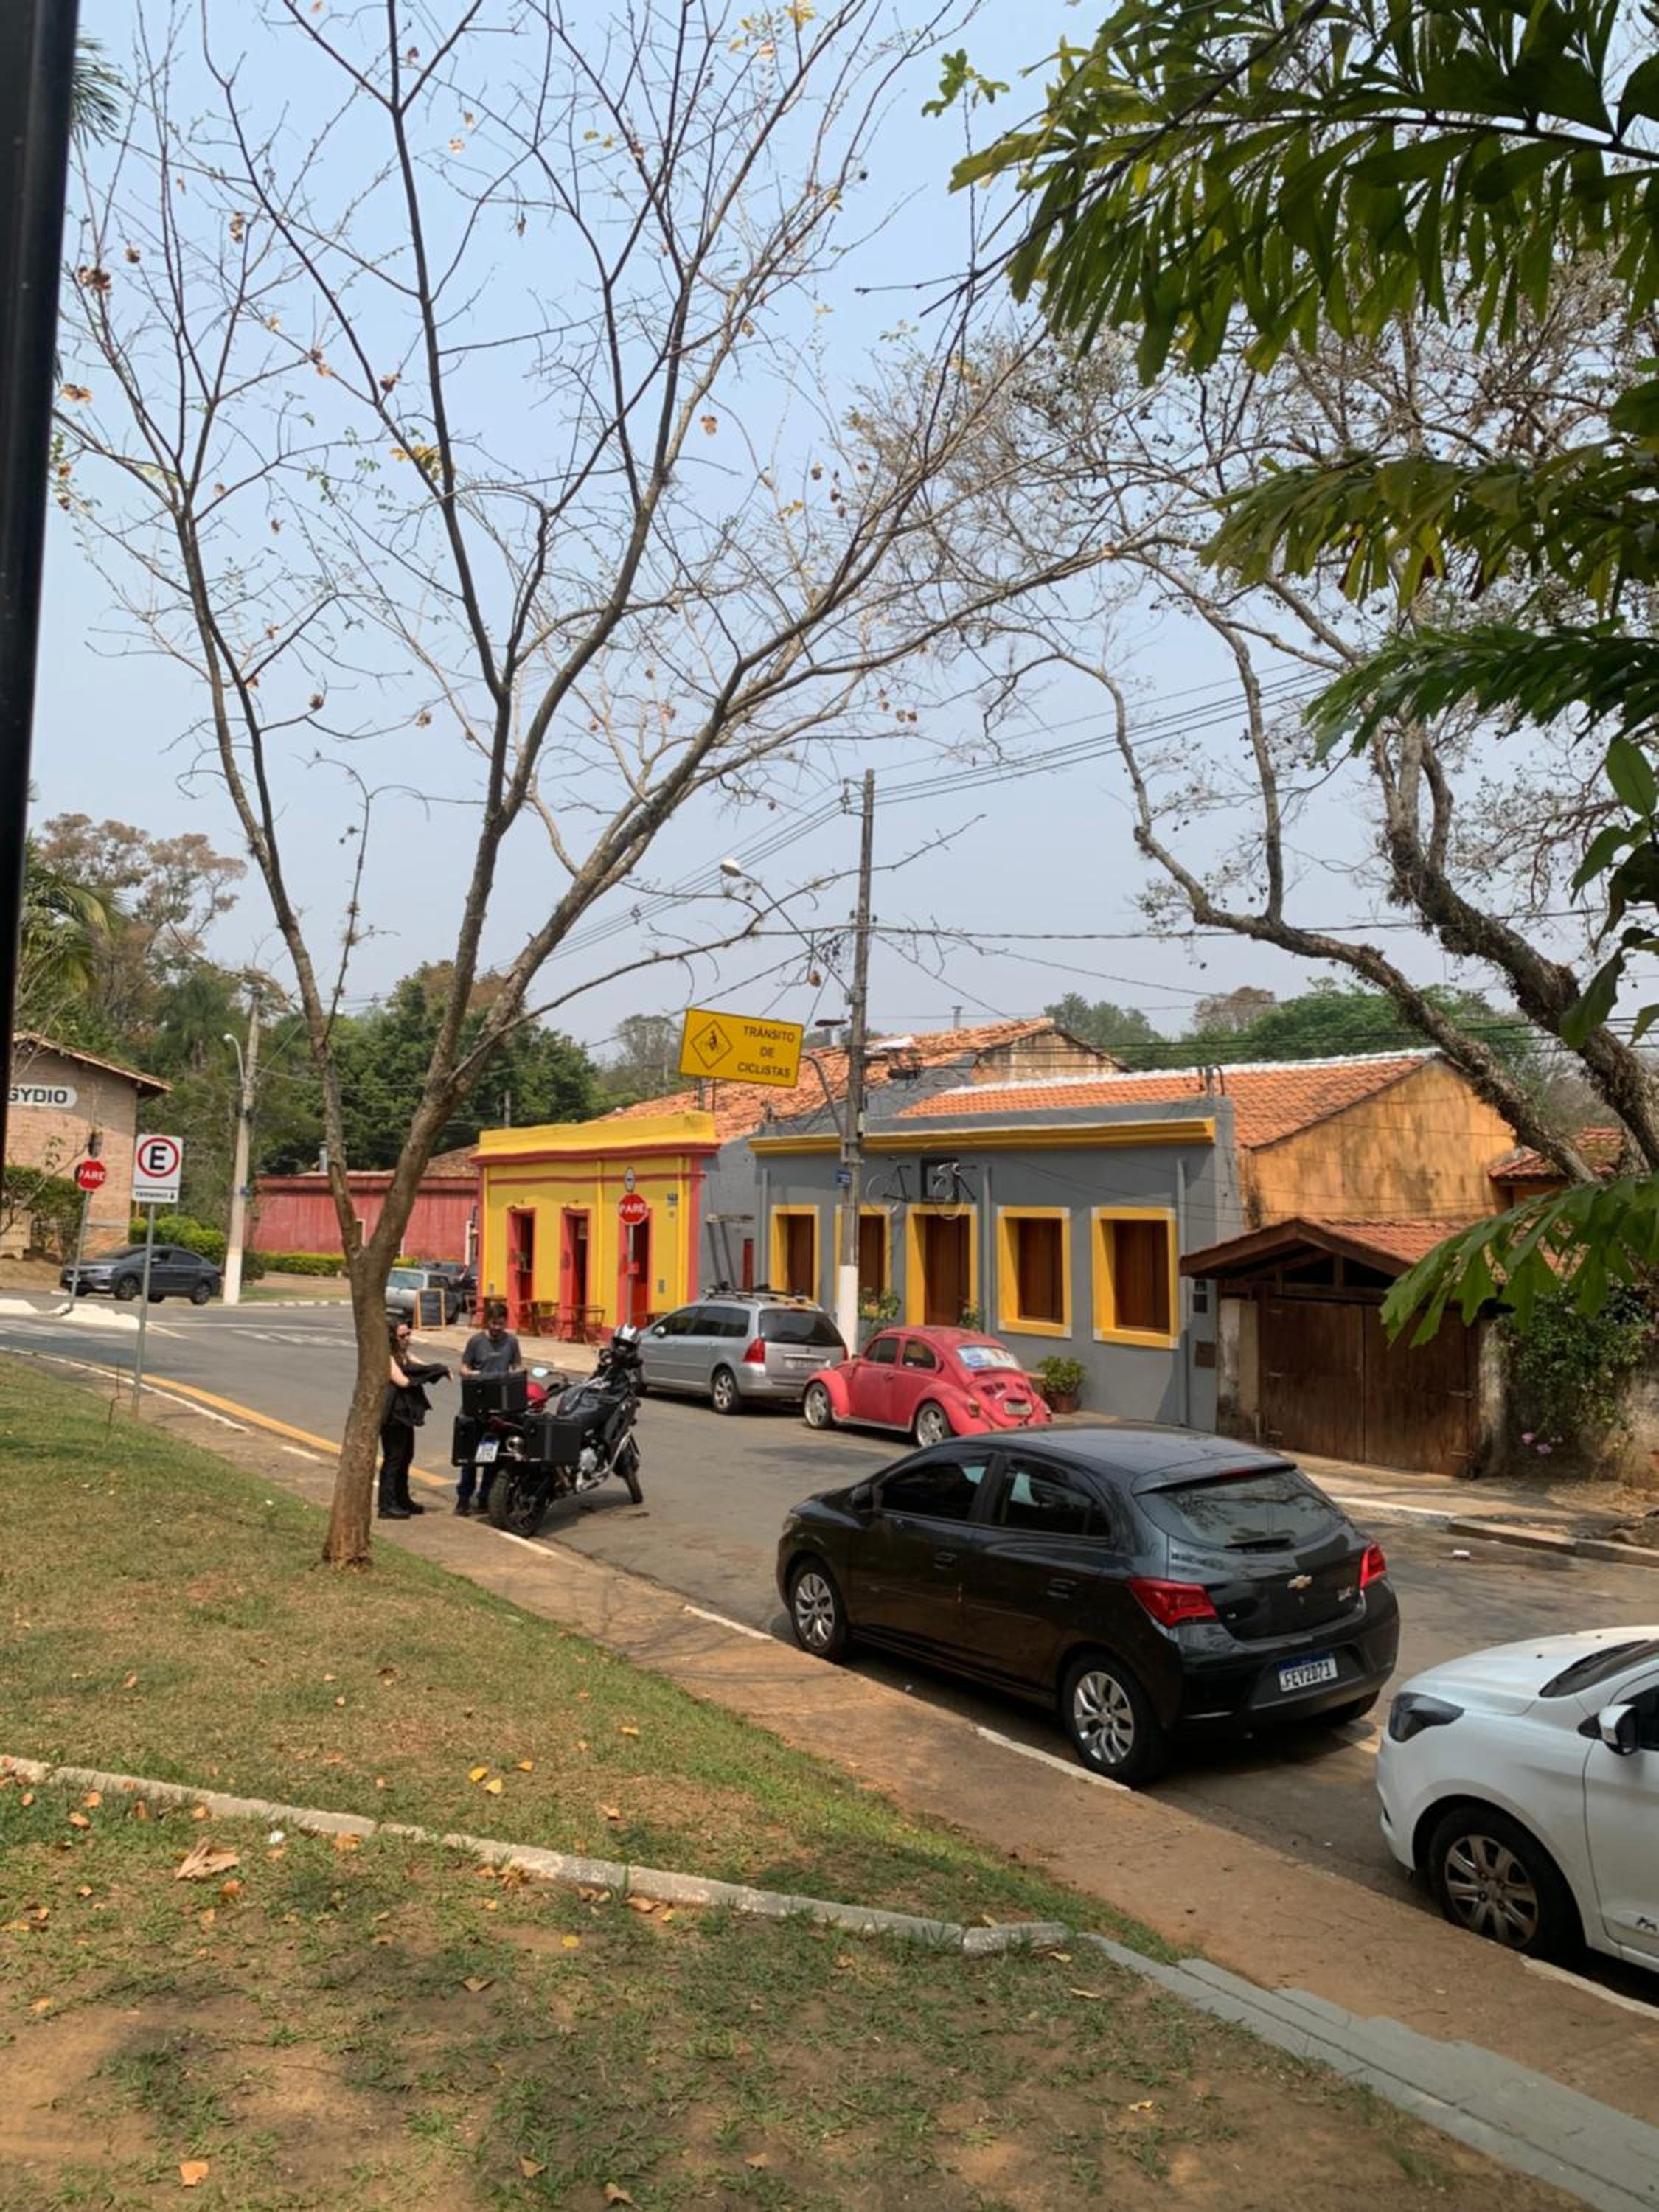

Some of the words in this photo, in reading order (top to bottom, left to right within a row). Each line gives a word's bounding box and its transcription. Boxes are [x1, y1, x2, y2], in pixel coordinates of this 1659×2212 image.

[761, 1046, 775, 1059] DE
[738, 1062, 790, 1078] CICLISTAS
[150, 1145, 167, 1170] E
[619, 1203, 645, 1214] PARE
